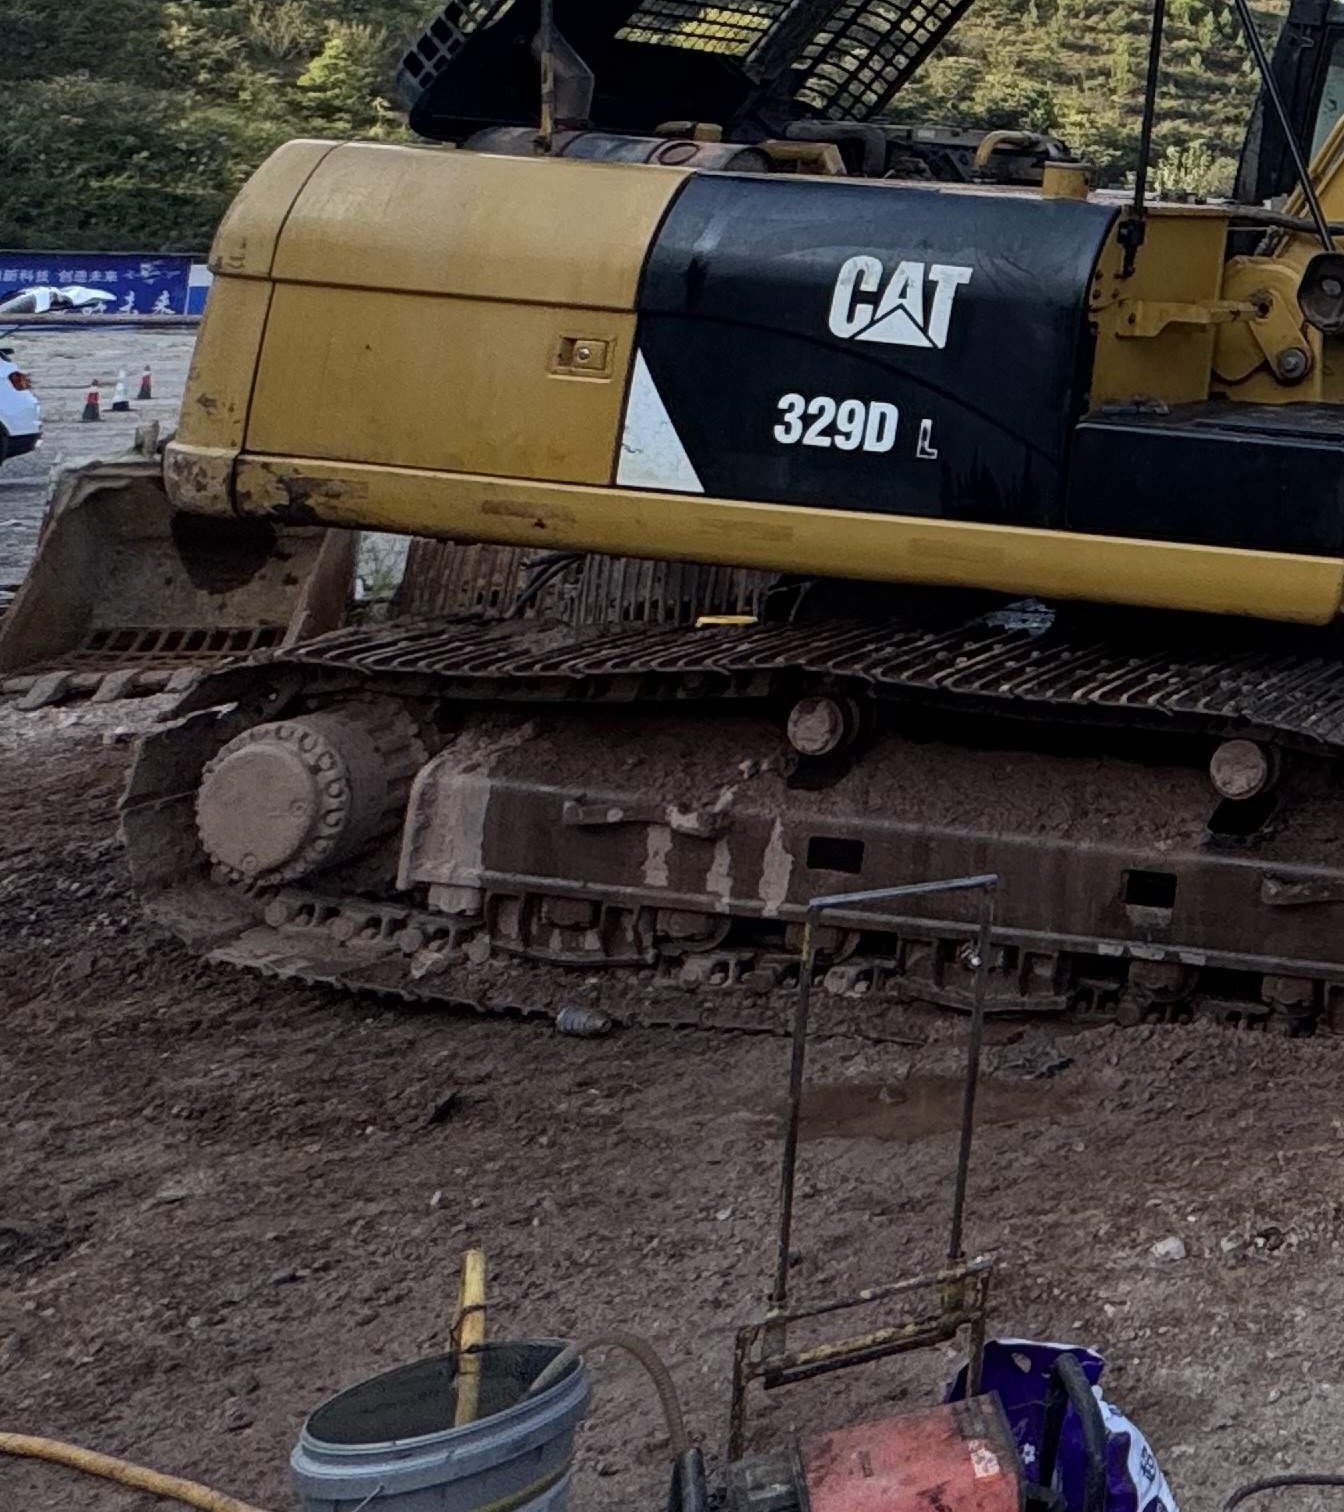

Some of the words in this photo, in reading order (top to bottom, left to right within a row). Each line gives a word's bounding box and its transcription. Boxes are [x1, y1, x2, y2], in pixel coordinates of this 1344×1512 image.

[0, 269, 50, 283] 新科技
[828, 255, 974, 349] CAT
[773, 393, 899, 452] 329D
[915, 419, 938, 459] L
